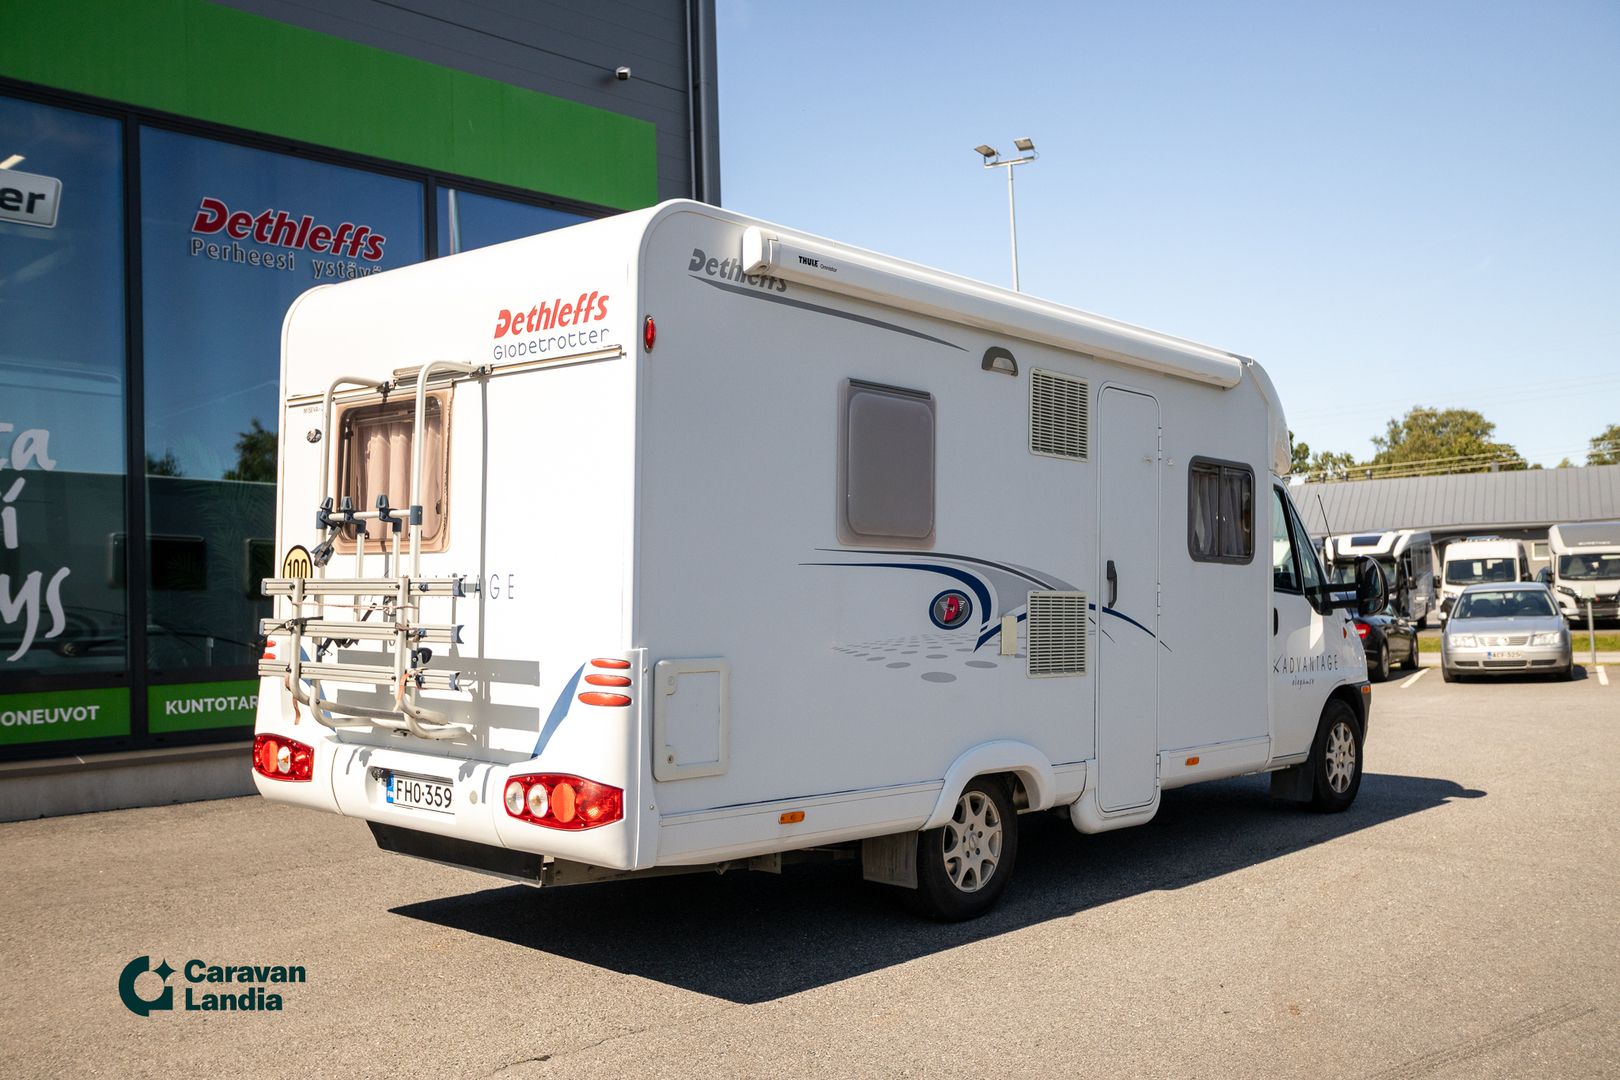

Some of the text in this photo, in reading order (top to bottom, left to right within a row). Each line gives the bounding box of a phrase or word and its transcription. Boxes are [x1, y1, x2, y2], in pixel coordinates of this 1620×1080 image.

[192, 197, 386, 262] Dethleffs
[191, 238, 295, 271] Perheesi
[798, 255, 819, 268] THULE
[494, 291, 609, 339] Dethleffs
[493, 328, 610, 360] Globetrotter
[287, 558, 308, 579] 100
[1282, 654, 1339, 674] ADVANTAGE
[396, 779, 453, 809] FHO-359
